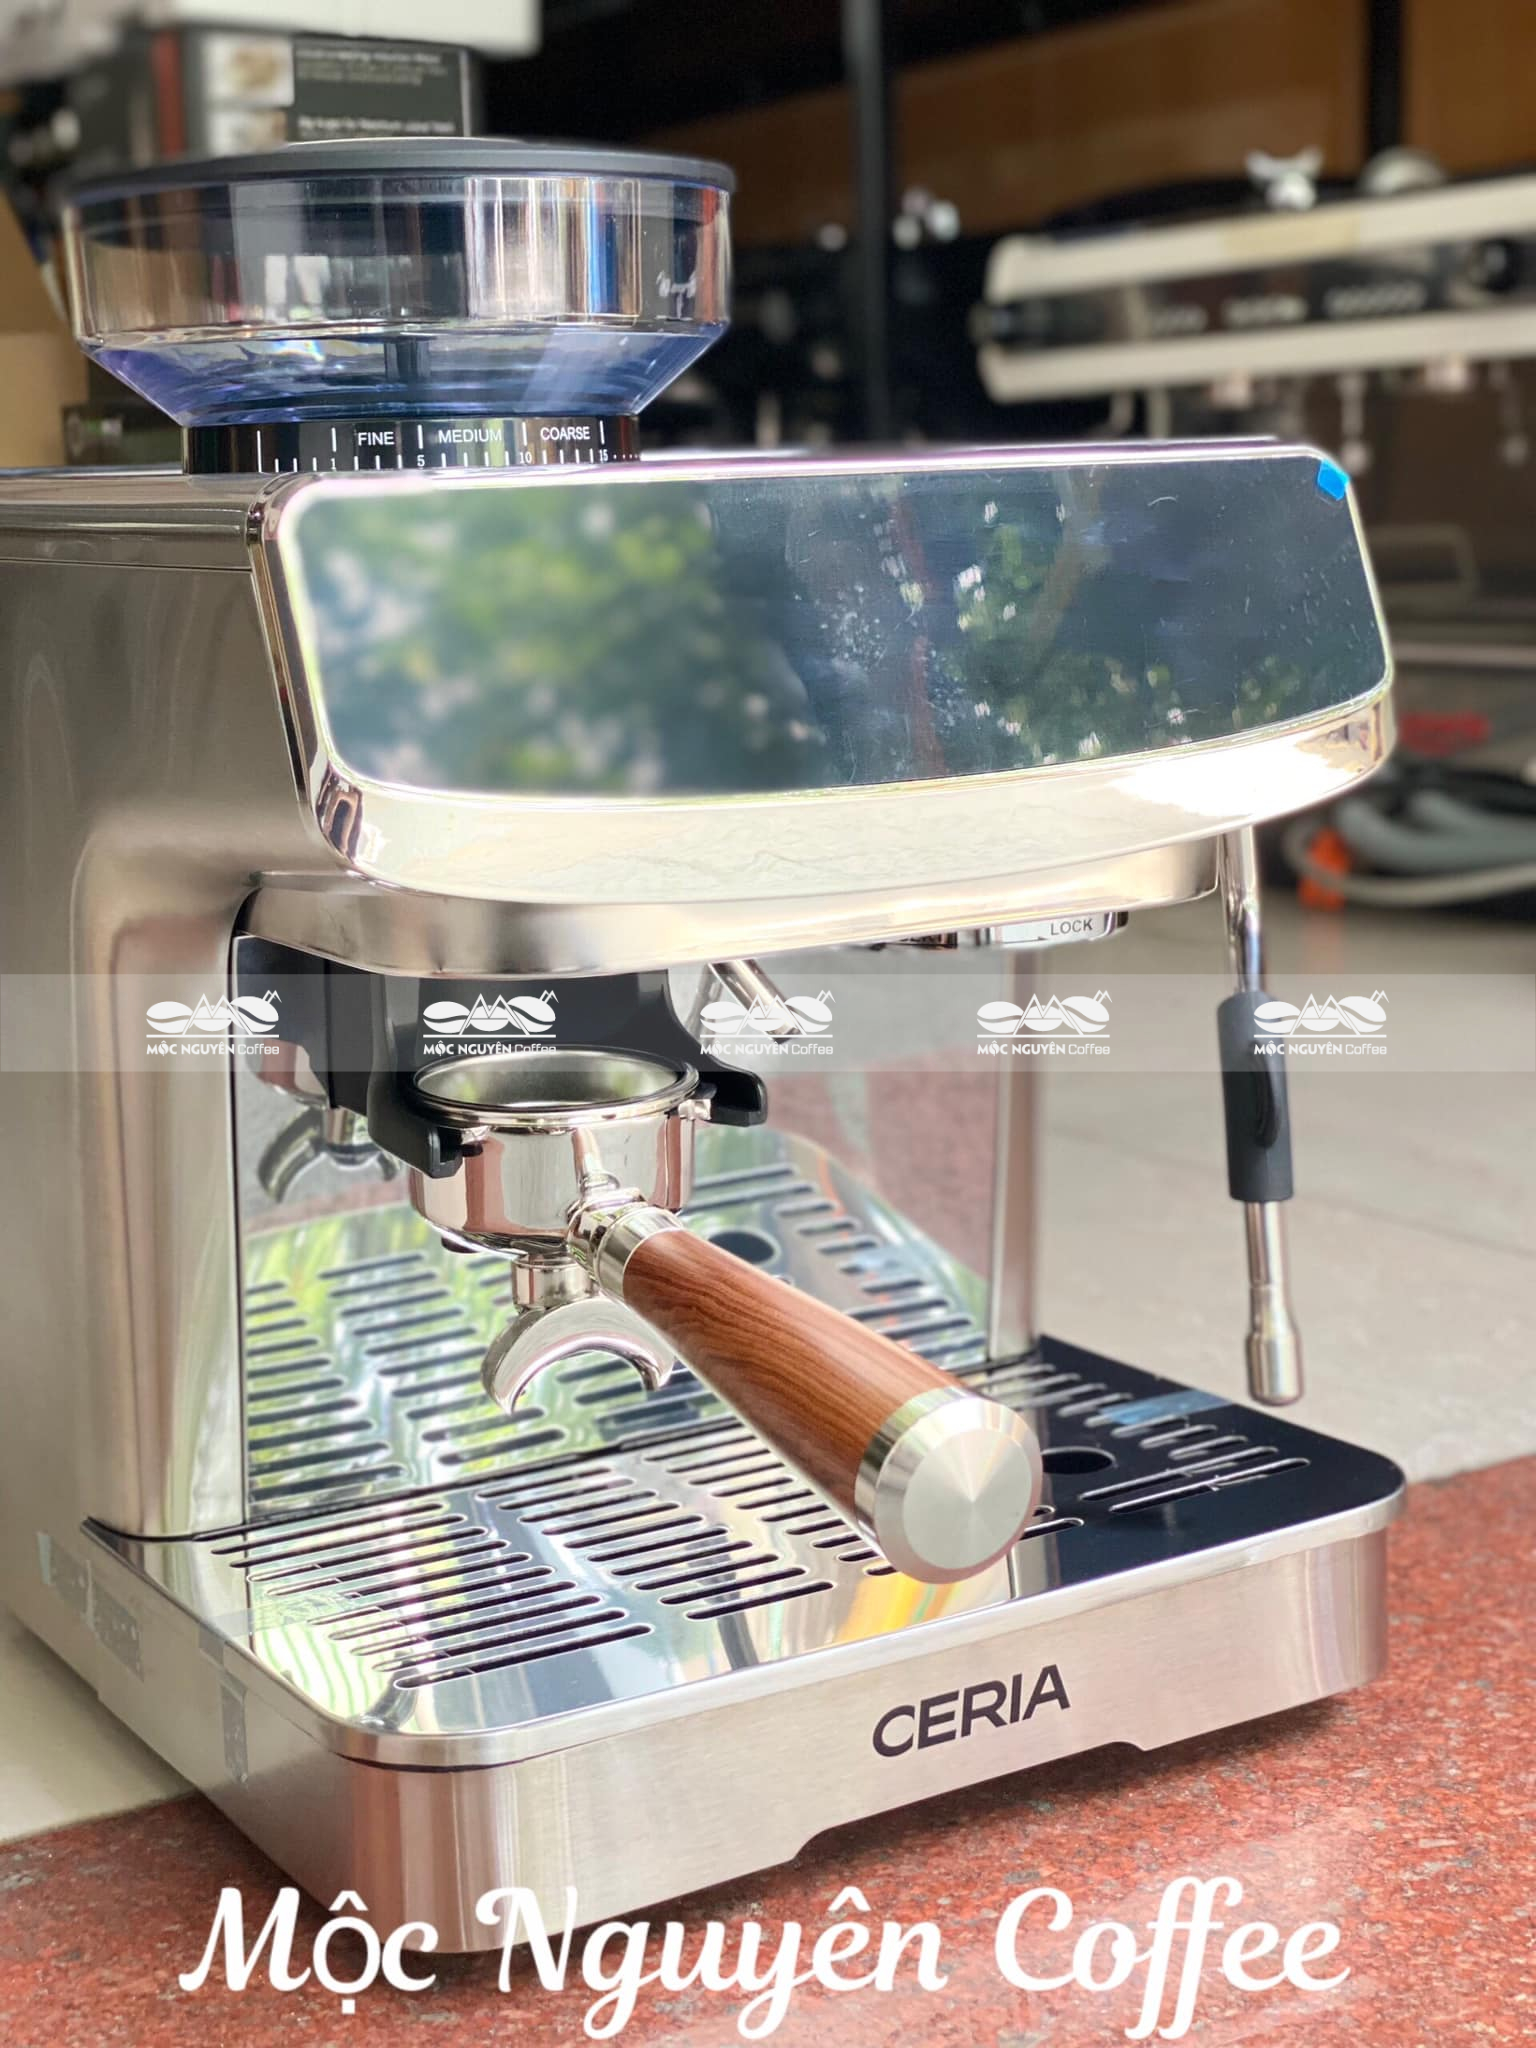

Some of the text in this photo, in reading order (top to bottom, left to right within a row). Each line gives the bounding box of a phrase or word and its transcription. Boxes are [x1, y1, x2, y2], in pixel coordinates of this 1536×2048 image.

[357, 425, 591, 447] FINE MEDIUM COARSE
[330, 448, 609, 470] 1 5 10 15
[1050, 917, 1093, 936] LOCK
[872, 1664, 1071, 1758] CERIA
